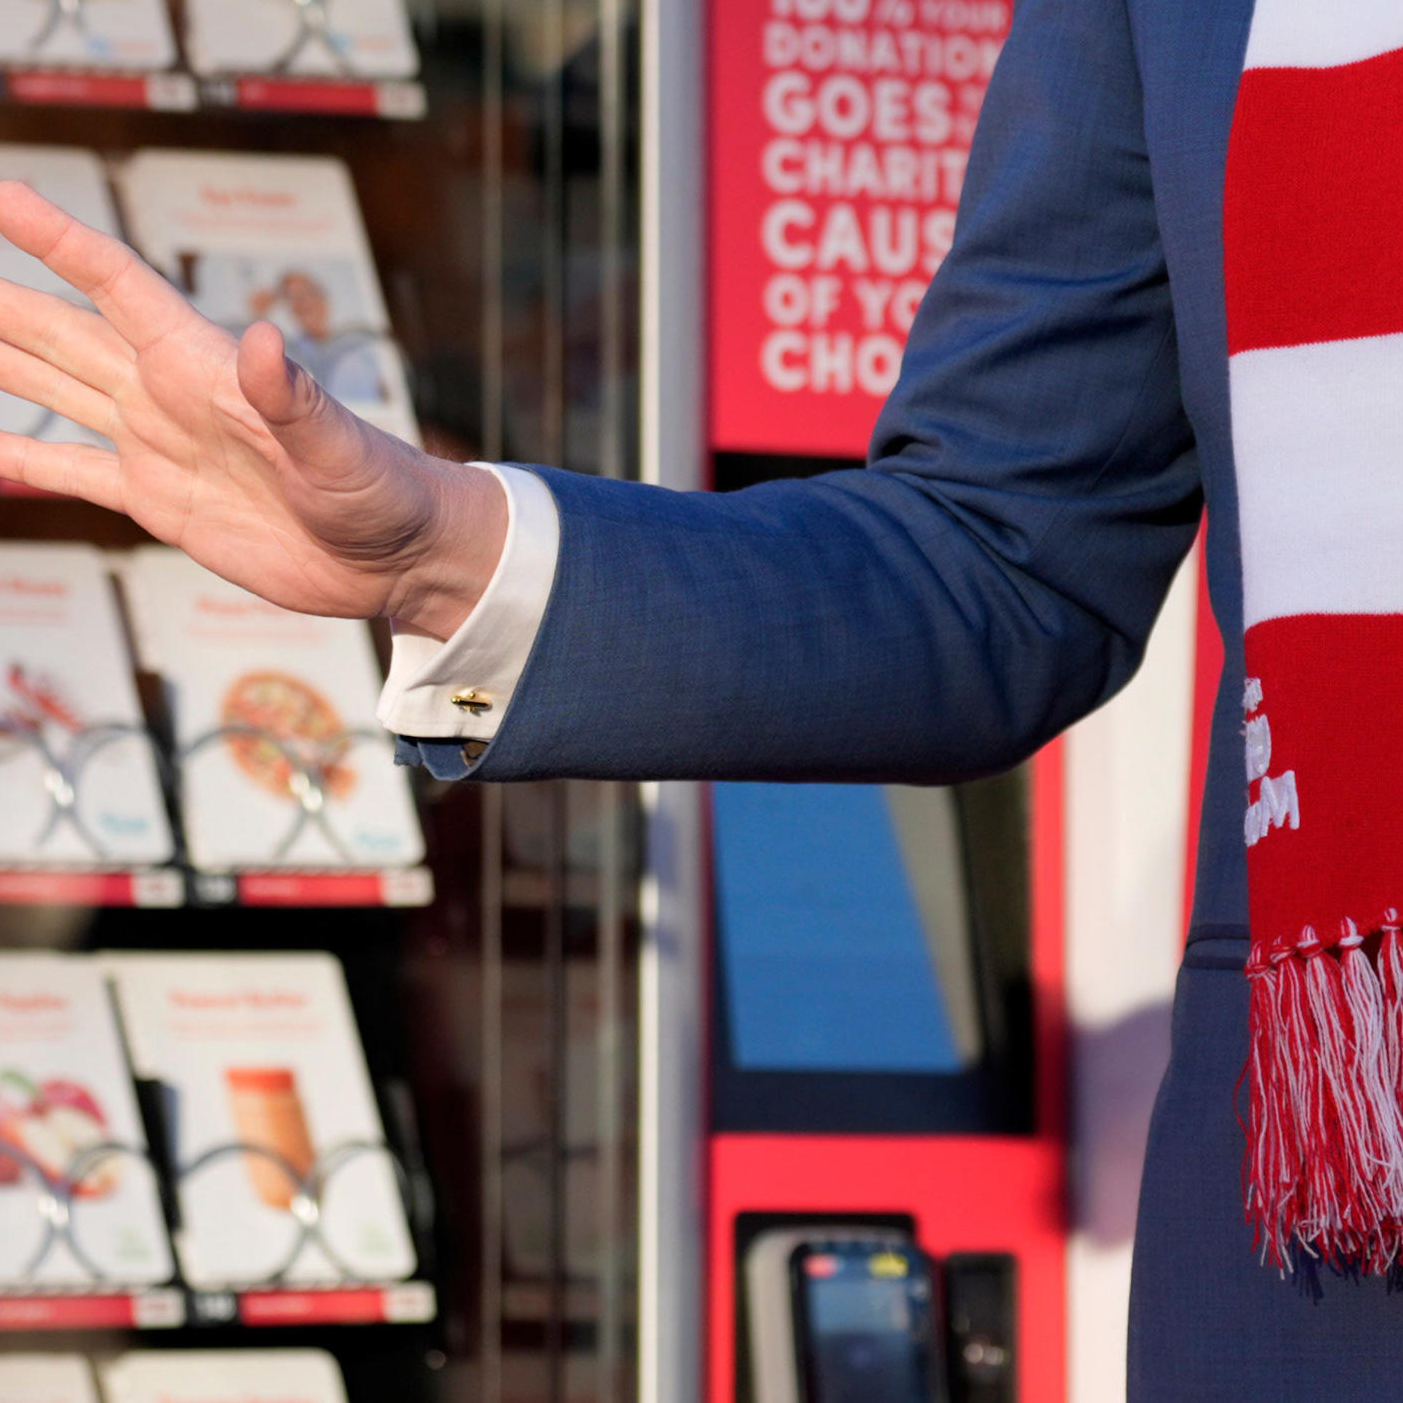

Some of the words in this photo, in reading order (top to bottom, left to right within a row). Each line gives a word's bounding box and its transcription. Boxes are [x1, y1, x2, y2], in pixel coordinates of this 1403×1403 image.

[763, 70, 952, 145] GOES
[762, 137, 969, 204] CHARIT
[762, 198, 957, 278] CAUS
[763, 272, 842, 328] OF
[852, 278, 929, 333] YO
[761, 328, 905, 396] CHO
